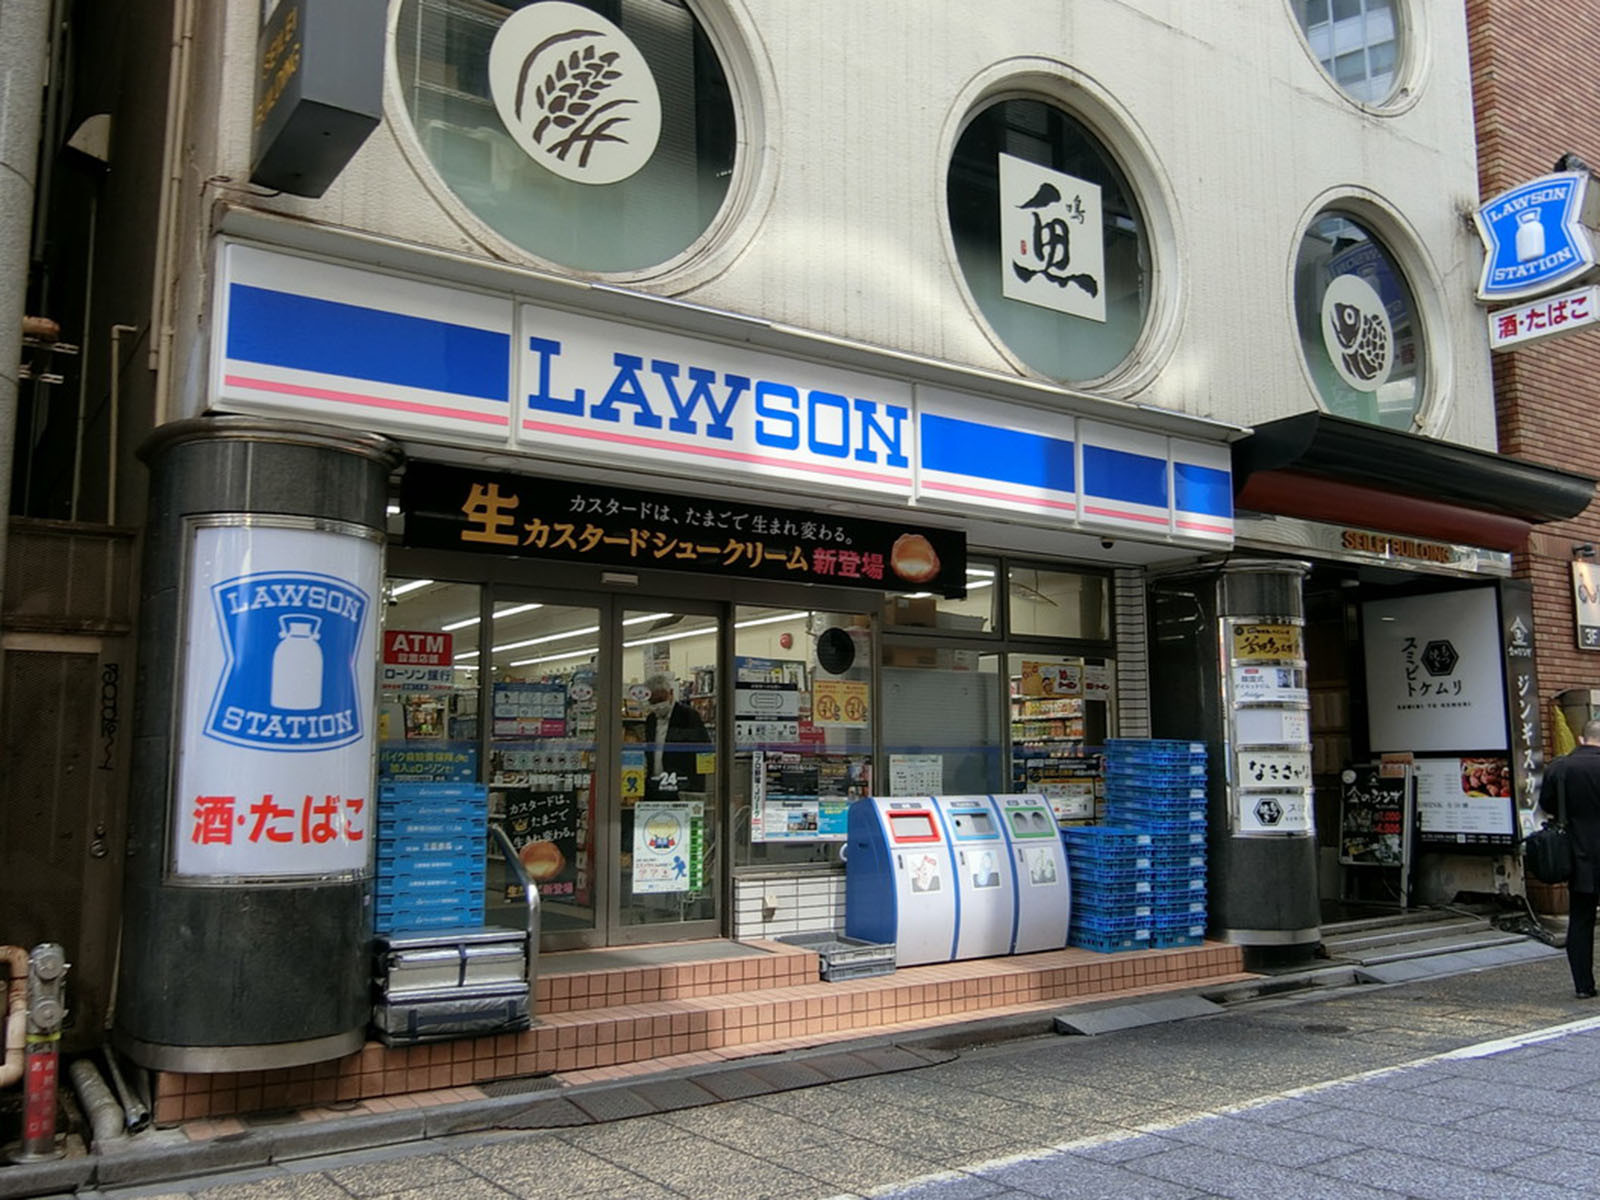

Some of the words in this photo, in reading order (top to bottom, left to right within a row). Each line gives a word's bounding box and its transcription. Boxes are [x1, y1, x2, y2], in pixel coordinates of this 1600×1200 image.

[1490, 186, 1568, 224] LAWSON
[1014, 182, 1098, 299] 魚
[1494, 247, 1572, 281] STATION
[1498, 296, 1589, 339] 酒・たばこ
[528, 336, 909, 469] LAWSON
[228, 584, 361, 622] LAWSON
[392, 634, 444, 653] ATM
[1584, 628, 1599, 645] 3F
[222, 706, 354, 739] STATION
[660, 772, 678, 786] 24
[192, 795, 365, 845] 酒・たばこ
